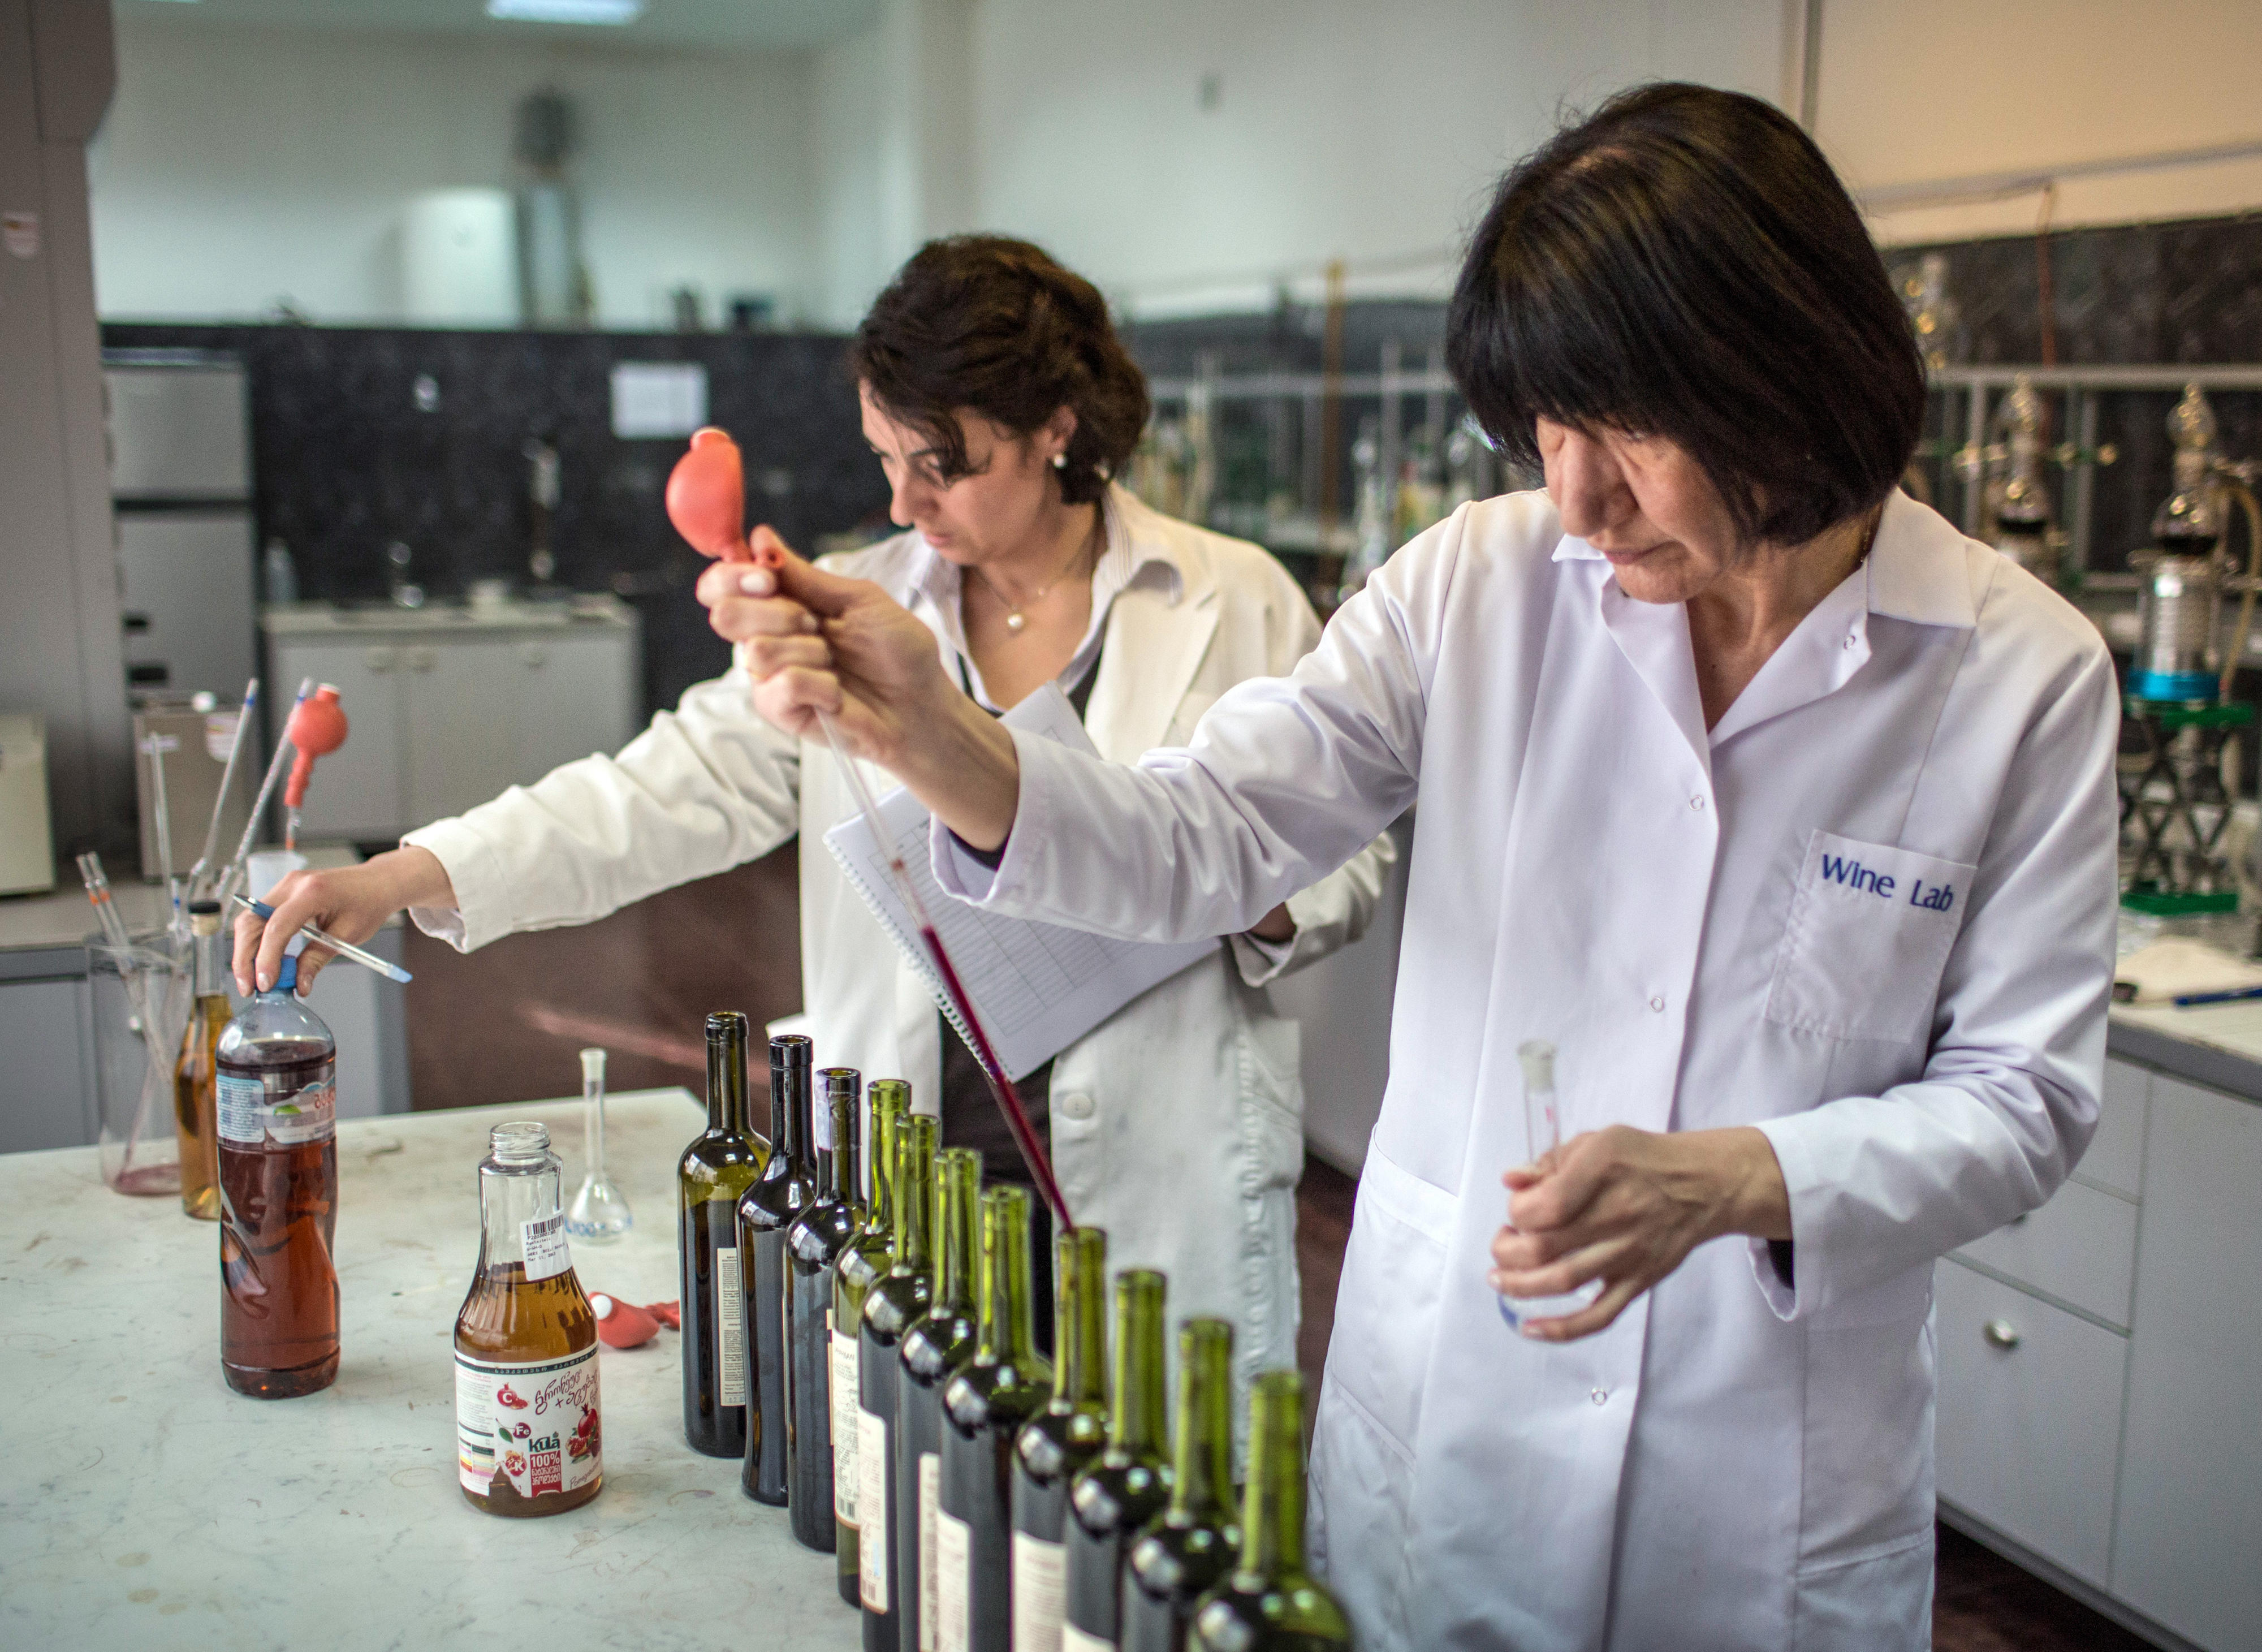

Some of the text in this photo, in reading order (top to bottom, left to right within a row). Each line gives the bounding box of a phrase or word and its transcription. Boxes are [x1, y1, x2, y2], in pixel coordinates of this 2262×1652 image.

[1822, 853, 1954, 912] Wine Lab
[502, 1392, 513, 1403] C
[515, 1425, 530, 1436] Fe
[531, 1451, 560, 1468] 100%
[515, 1461, 524, 1472] K
